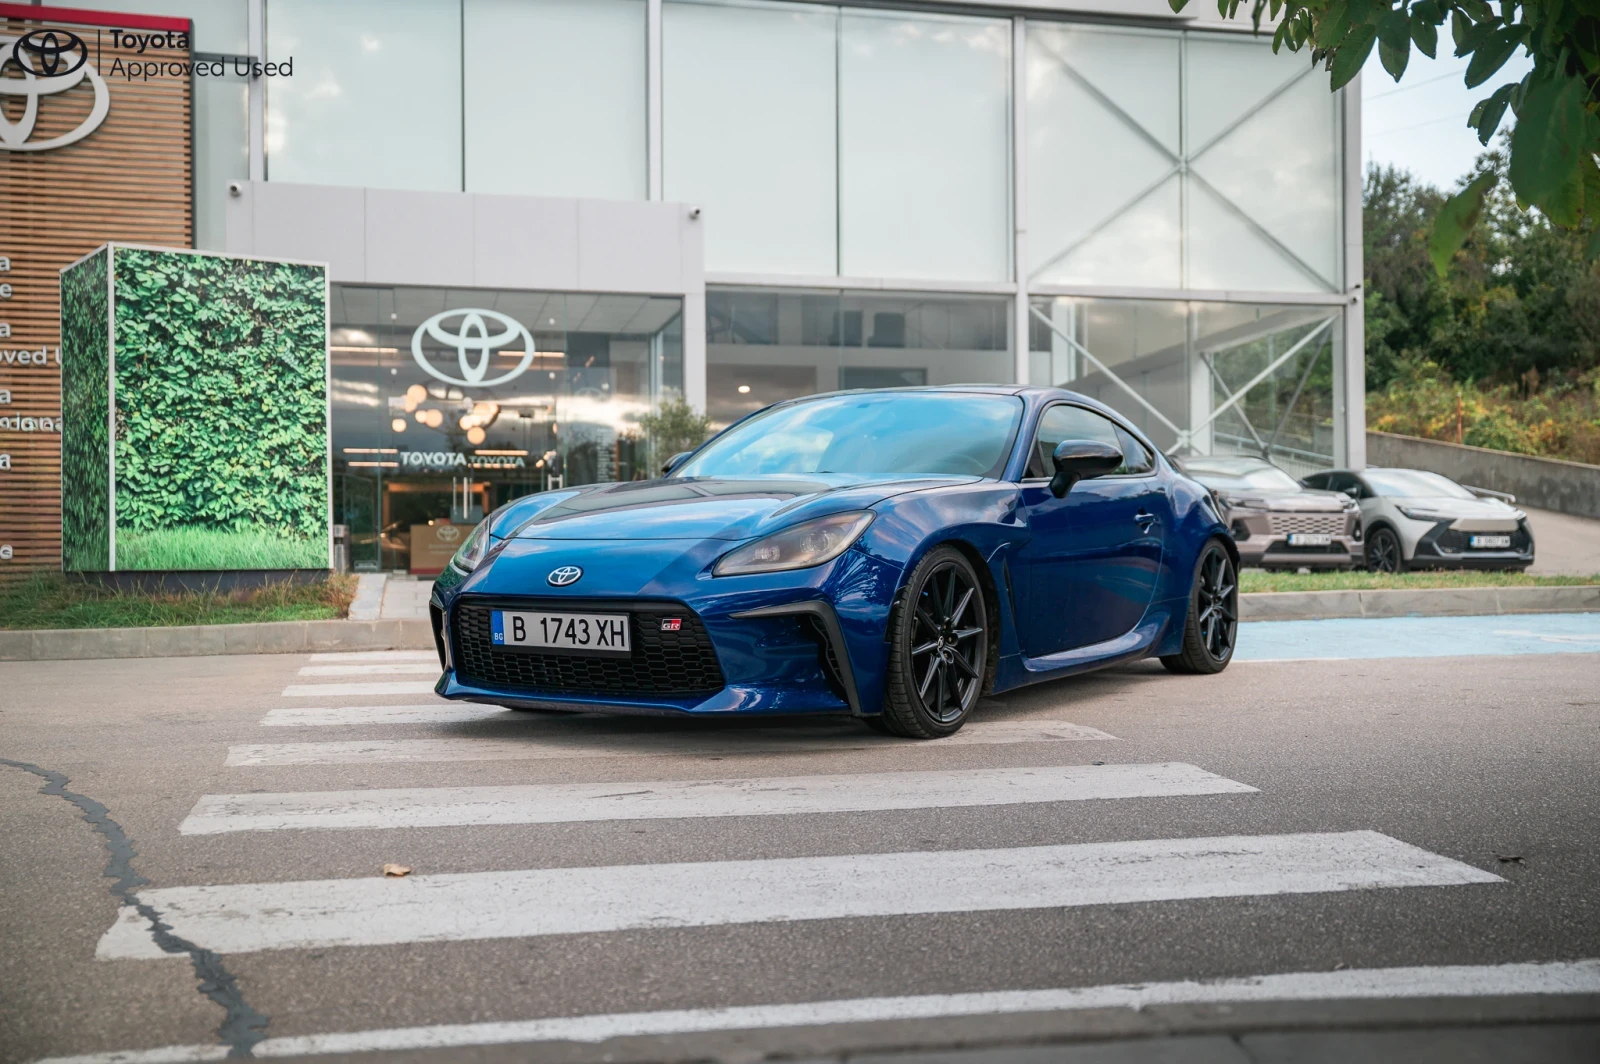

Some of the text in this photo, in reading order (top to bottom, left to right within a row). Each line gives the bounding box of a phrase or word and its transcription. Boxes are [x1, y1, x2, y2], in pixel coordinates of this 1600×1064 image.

[400, 451, 467, 466] TOYOTA
[512, 616, 625, 647] B 1743 XH
